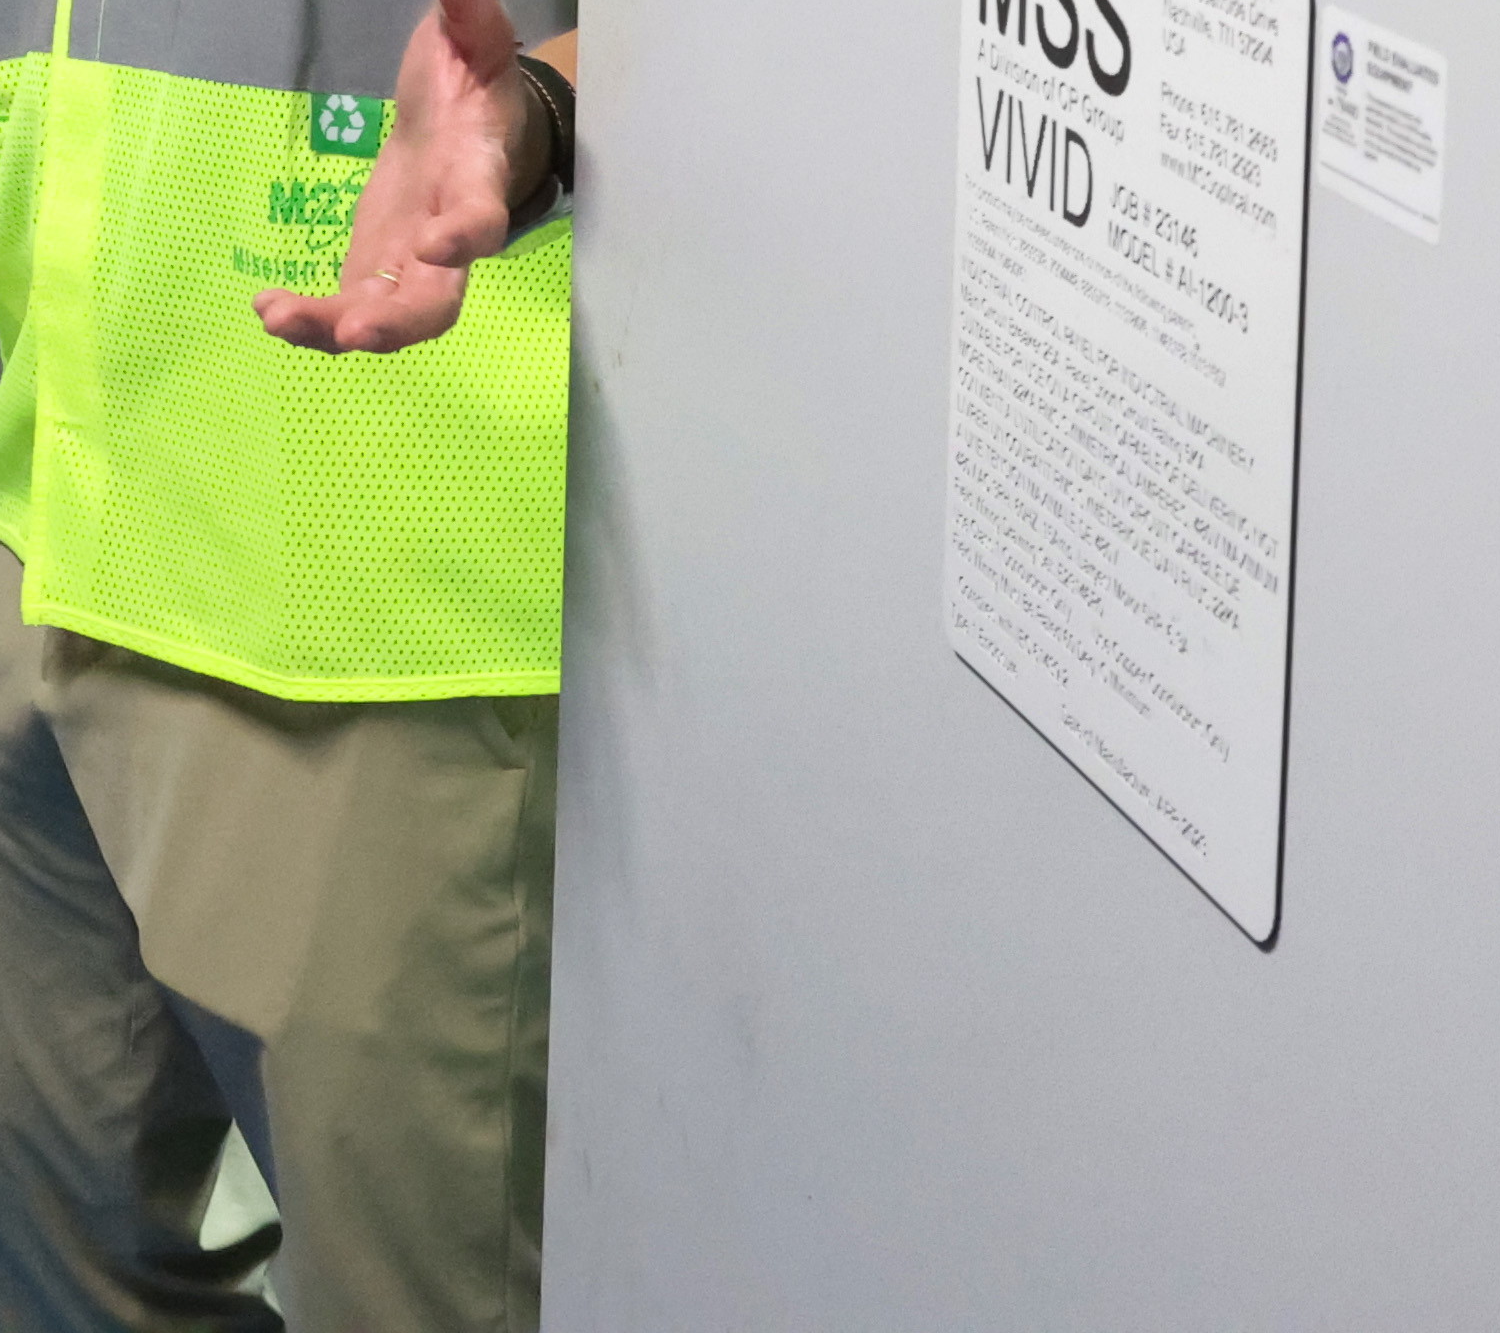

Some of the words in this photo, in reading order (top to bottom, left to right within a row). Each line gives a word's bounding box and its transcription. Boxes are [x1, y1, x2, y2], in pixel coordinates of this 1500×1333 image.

[978, 37, 988, 62] A
[989, 43, 1041, 90] Division
[1041, 71, 1057, 101] of
[1058, 81, 1081, 118] CP
[1082, 93, 1126, 145] Group
[976, 76, 1094, 229] VIVID
[1110, 182, 1142, 214] JOB
[1107, 220, 1161, 279] MODEL
